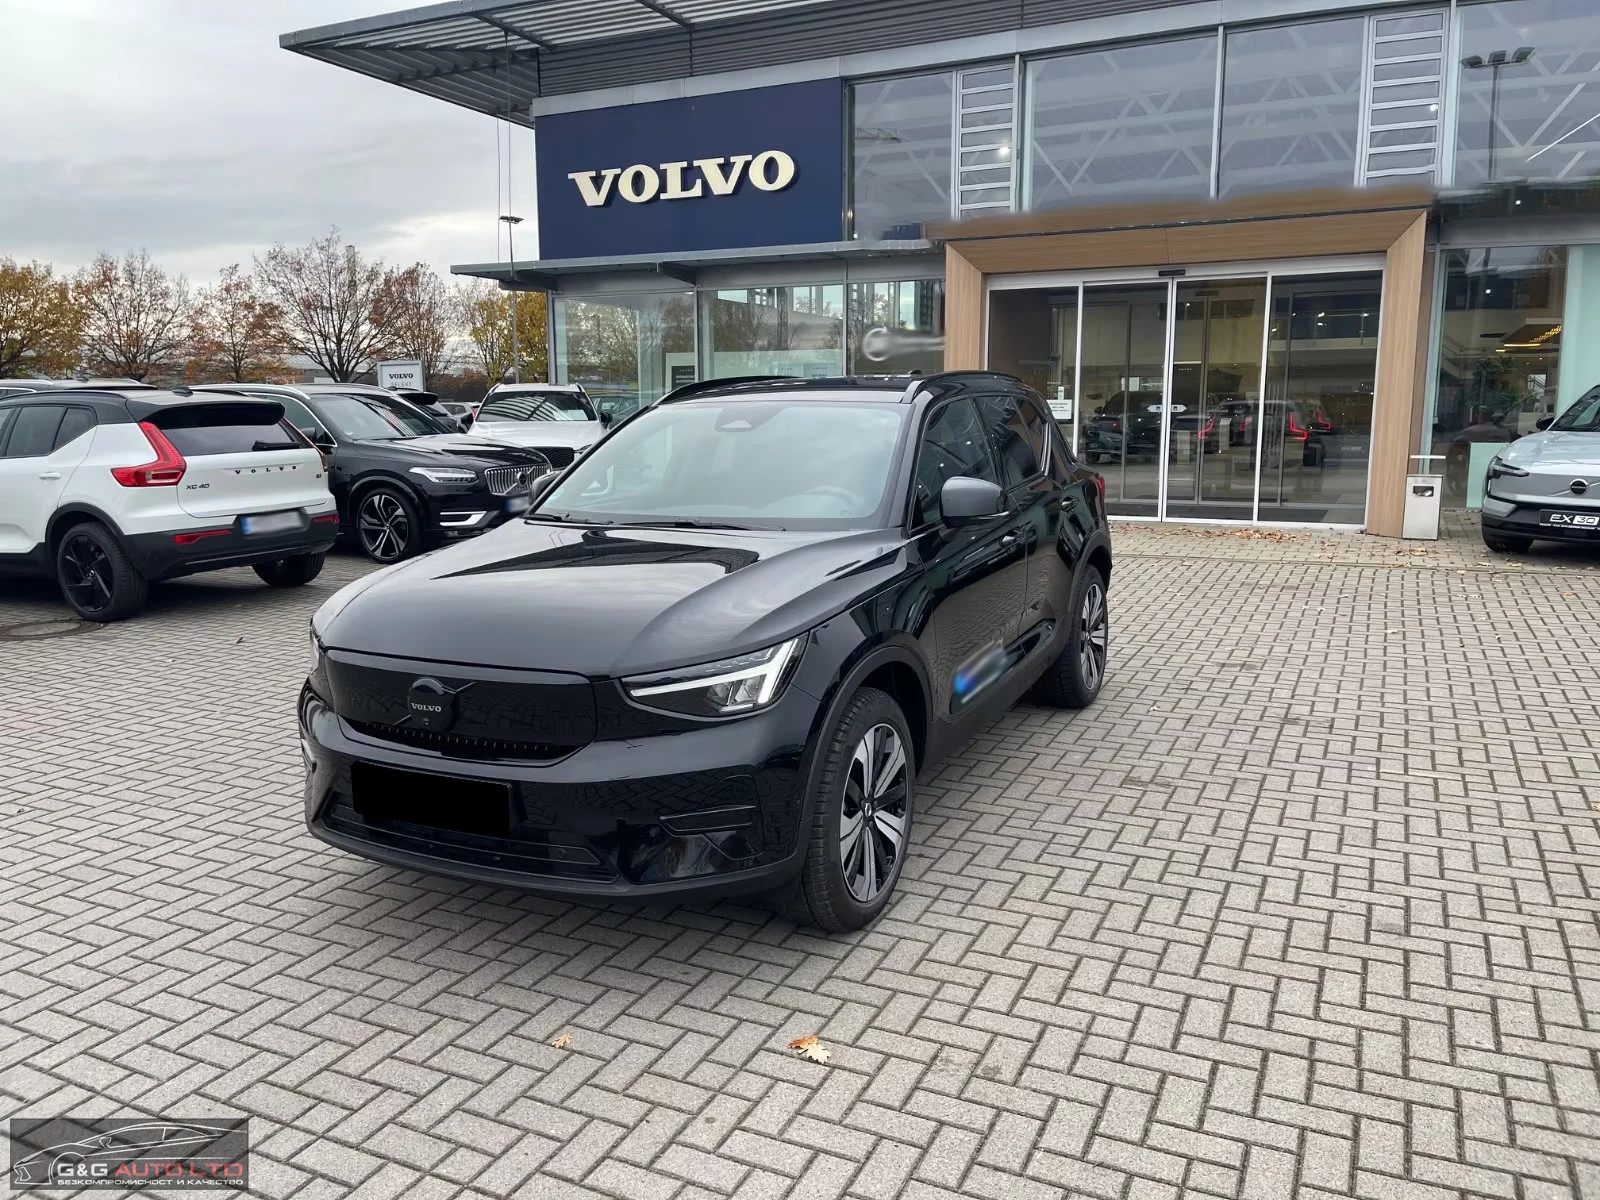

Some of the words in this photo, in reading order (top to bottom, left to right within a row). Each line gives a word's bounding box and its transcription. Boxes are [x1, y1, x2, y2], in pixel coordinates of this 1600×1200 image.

[567, 150, 795, 207] VOLVO
[234, 465, 297, 475] VOLVO
[410, 702, 442, 713] VOLVO
